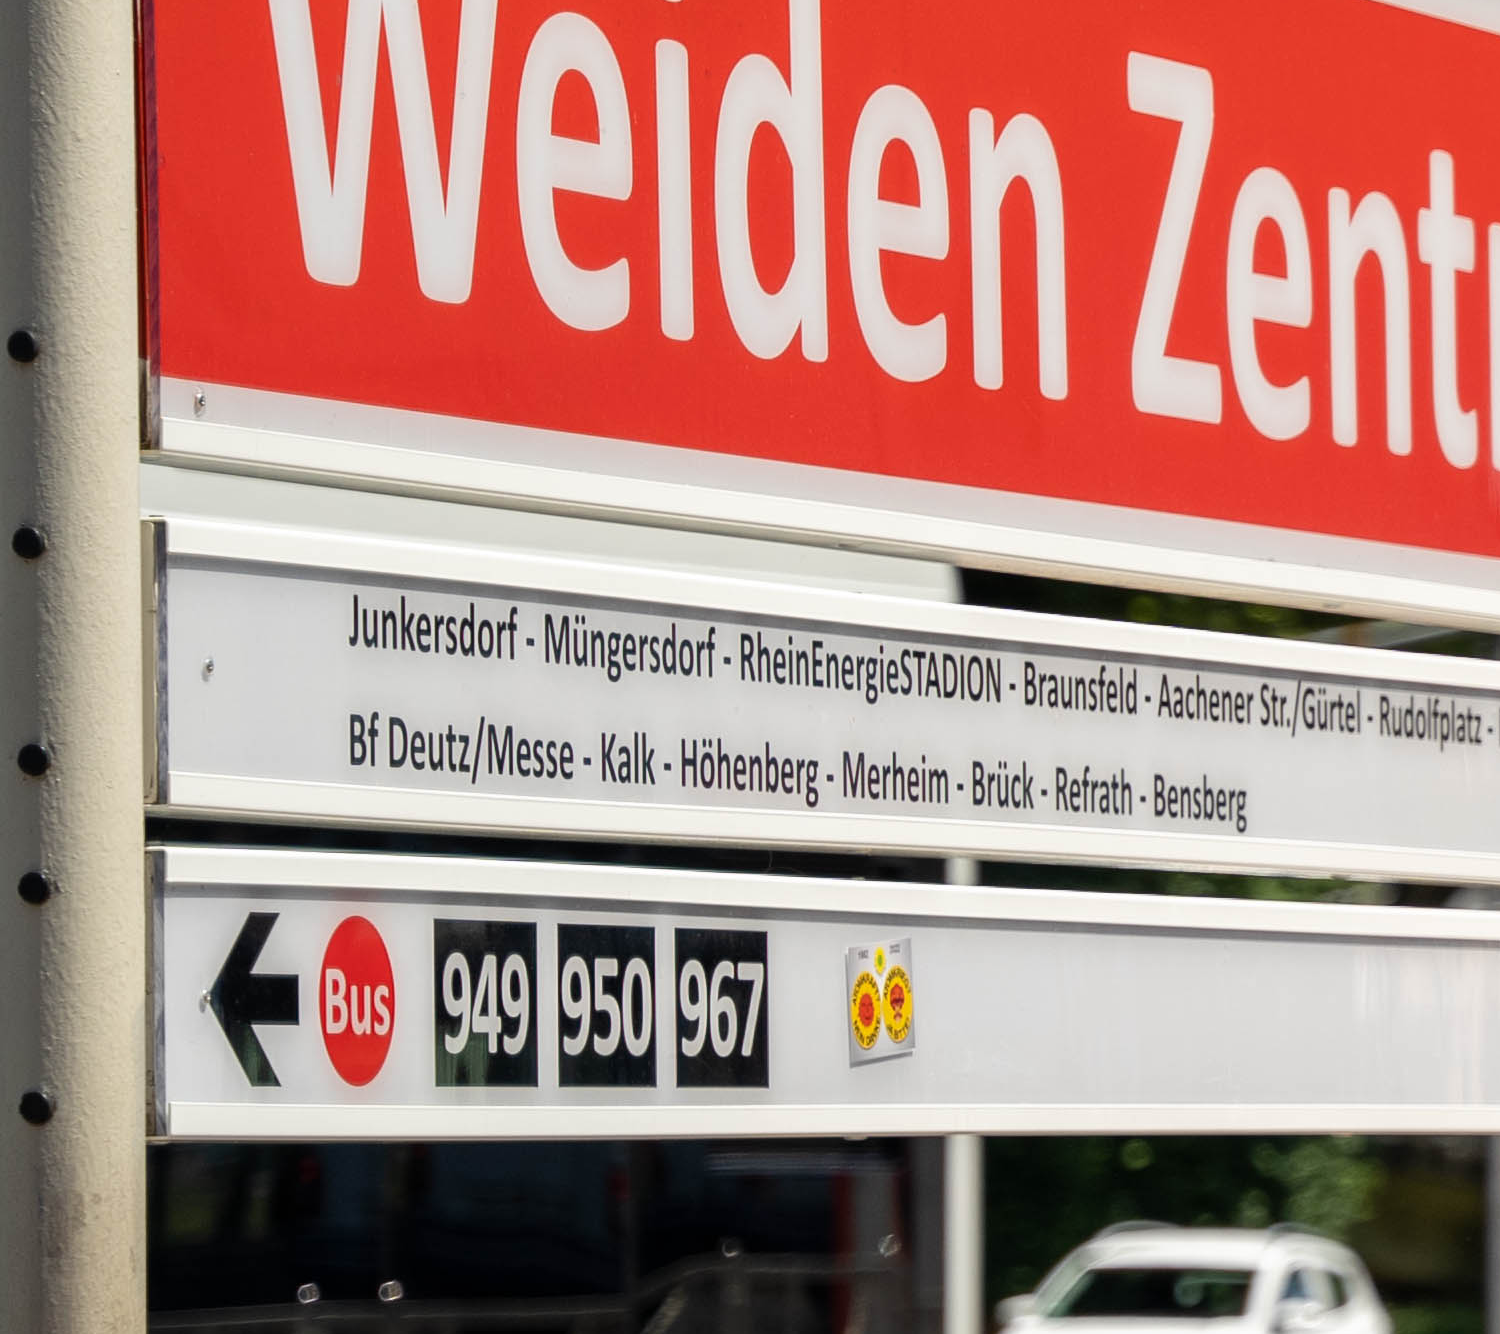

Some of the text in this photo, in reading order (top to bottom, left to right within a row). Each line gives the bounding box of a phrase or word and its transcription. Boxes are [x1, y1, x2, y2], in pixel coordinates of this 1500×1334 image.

[348, 594, 518, 660] Junkersdorf
[544, 613, 716, 682] Müngersdorf
[740, 630, 1001, 705] RheinEnergieSTADION
[1024, 660, 1138, 715] Braunsfeld
[1157, 673, 1254, 724] Aachener
[1260, 679, 1361, 737] Str./Gürtel
[1379, 695, 1482, 751] Rudolfplatz
[349, 711, 380, 767] Bf
[388, 715, 574, 785] Deutz/Messe
[601, 731, 656, 786] Kalk
[681, 737, 819, 808] Höhenberg
[842, 750, 949, 804] Merheim
[972, 760, 1034, 810] Brück
[1055, 765, 1133, 816] Refrath
[1153, 774, 1247, 833] Bensberg
[325, 968, 390, 1036] Bus
[442, 952, 530, 1055] 949
[561, 955, 652, 1057] 950
[679, 959, 764, 1058] 967
